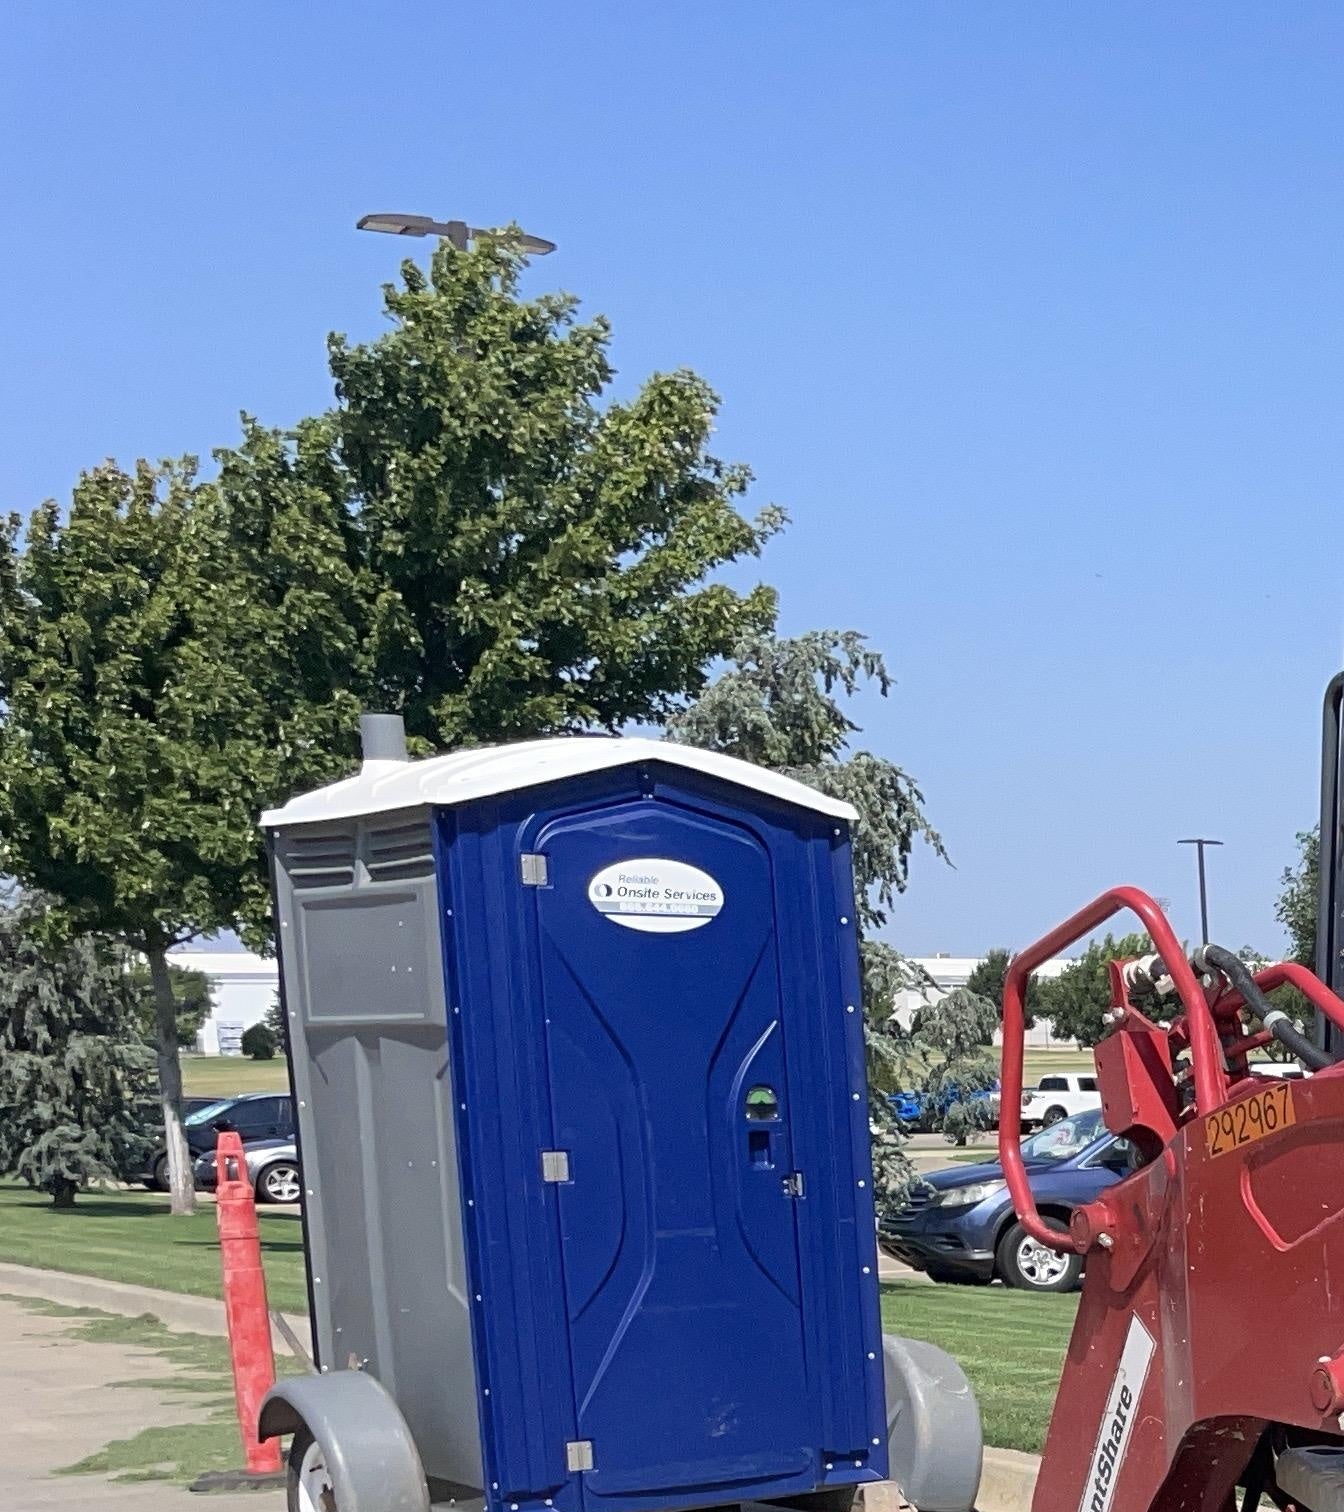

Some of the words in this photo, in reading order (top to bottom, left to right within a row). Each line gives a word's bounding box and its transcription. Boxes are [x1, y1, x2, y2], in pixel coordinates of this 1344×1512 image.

[617, 886, 660, 899] Onsite
[664, 888, 717, 902] Services
[1207, 1085, 1289, 1156] 292967
